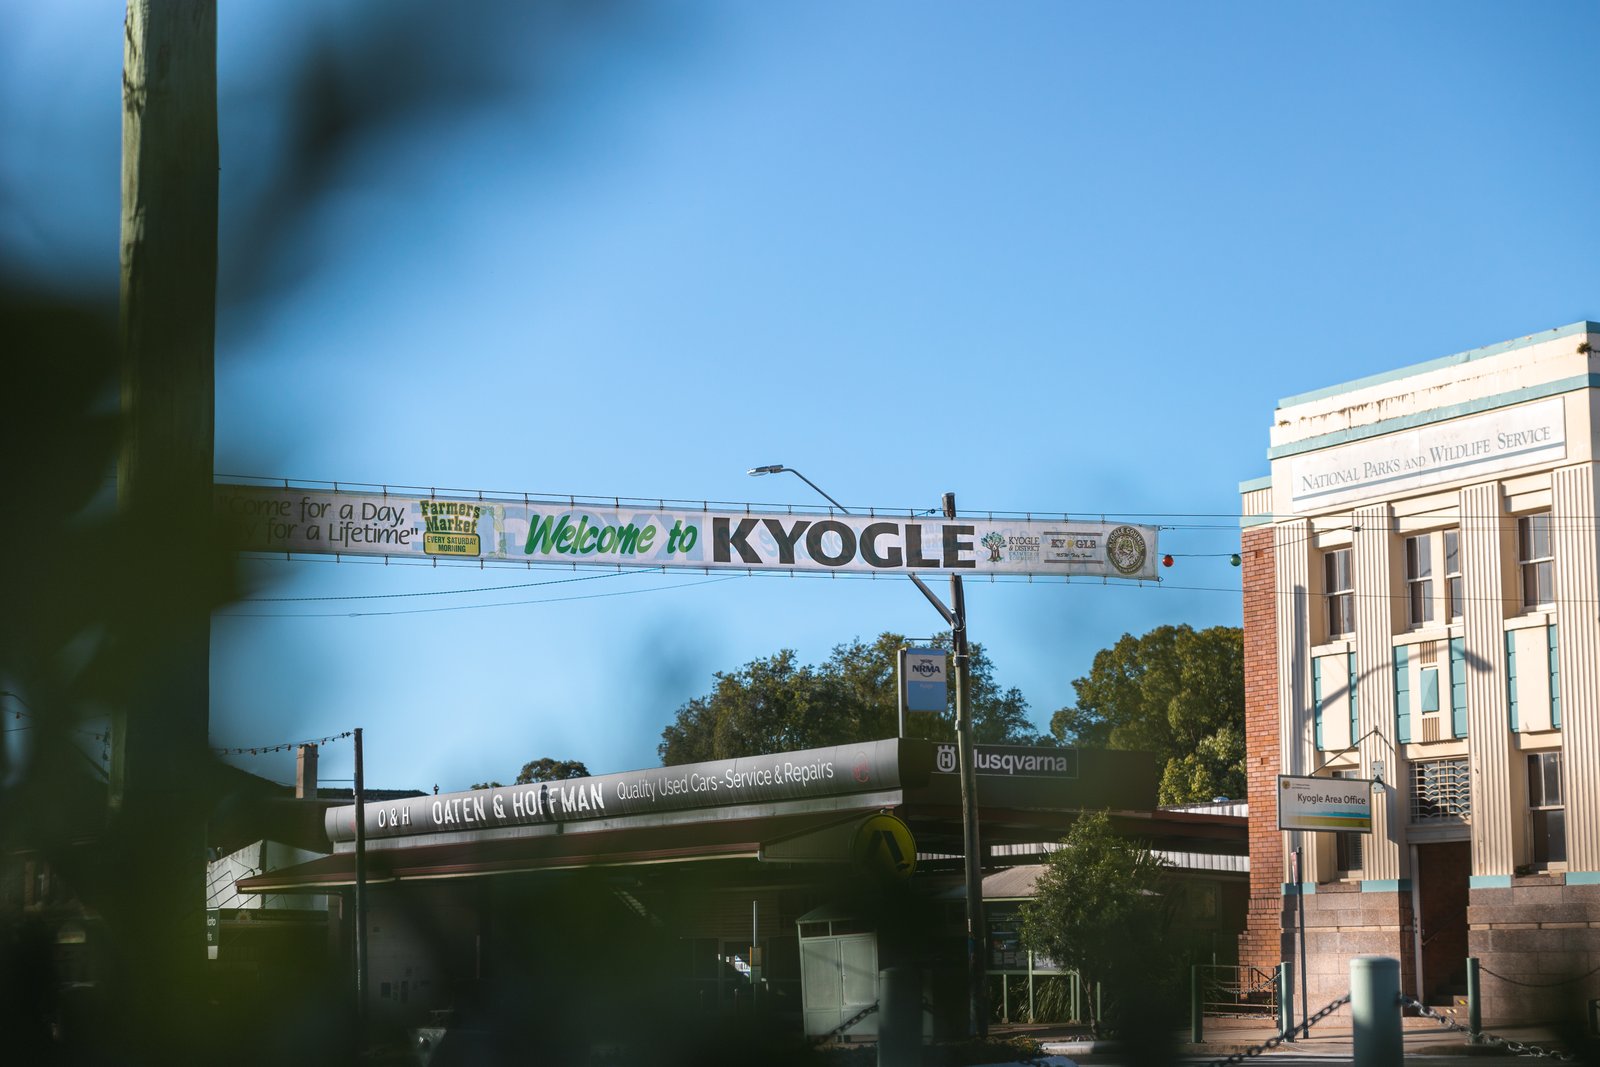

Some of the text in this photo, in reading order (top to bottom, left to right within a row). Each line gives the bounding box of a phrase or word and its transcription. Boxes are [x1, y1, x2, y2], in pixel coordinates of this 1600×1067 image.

[1302, 426, 1551, 491] NATIONAL PARKS AND WILDLIFE SERVICE
[299, 496, 332, 523] for
[339, 504, 354, 520] a
[361, 502, 405, 528] Day,
[420, 500, 480, 519] Farmers
[265, 517, 298, 544] for
[306, 525, 320, 541] a
[328, 521, 419, 548] Lifetime"
[424, 515, 478, 535] Market
[426, 535, 477, 545] EVERY SATURDAY
[438, 544, 467, 553] MORNING
[524, 514, 977, 569] Welcome to KYOGLE
[1008, 536, 1040, 545] KYOGLE
[912, 664, 941, 674] NRMA
[616, 779, 656, 802] Quality
[658, 773, 689, 797] Used
[690, 772, 718, 793] Cars
[725, 765, 772, 789] Service
[774, 764, 784, 785] &
[784, 758, 834, 787] Repairs
[432, 795, 487, 825] OATEN
[492, 793, 507, 819] &
[1297, 793, 1366, 805] Kyogle Area Office
[378, 806, 410, 828] O & H
